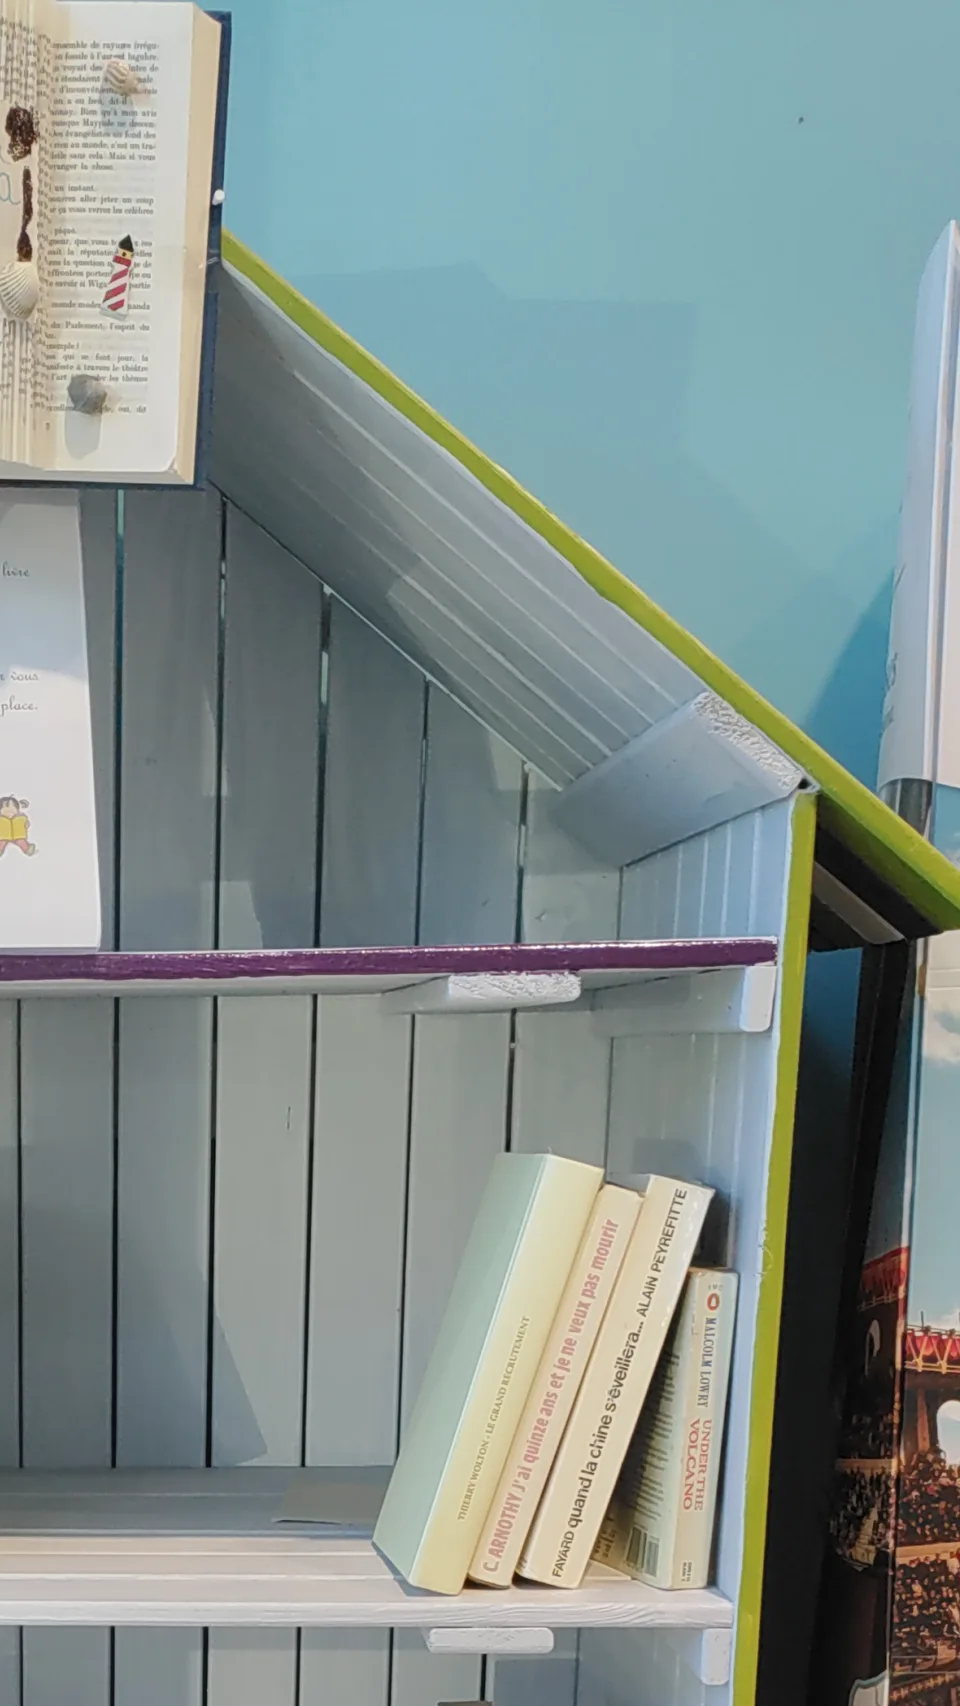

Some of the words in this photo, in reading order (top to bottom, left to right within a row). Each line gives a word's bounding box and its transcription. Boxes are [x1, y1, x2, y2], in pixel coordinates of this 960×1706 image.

[2, 561, 30, 578] livre
[10, 671, 39, 682] vous
[0, 696, 38, 717] place.
[587, 1218, 620, 1271] mourir
[649, 1186, 688, 1272] PEYREFITTE
[578, 1271, 603, 1300] pas
[635, 1273, 660, 1316] ALAIN
[567, 1299, 591, 1335] veux
[500, 1314, 531, 1385] RECRUTEMENT
[559, 1334, 578, 1357] ne
[700, 1316, 717, 1367] MALCOLM
[546, 1367, 567, 1390] et
[553, 1354, 574, 1372] je
[489, 1385, 508, 1421] GRAND
[538, 1389, 559, 1417] ans
[696, 1370, 711, 1407] LOWRY
[485, 1422, 496, 1434] LE
[519, 1415, 552, 1465] quinze
[587, 1412, 614, 1459] chine
[680, 1417, 701, 1510] VOLCANO
[697, 1419, 712, 1474] UNDER
[456, 1481, 477, 1521] THIERRY
[470, 1439, 491, 1480] WOLTON
[511, 1464, 533, 1493] J'ai
[581, 1458, 598, 1476] la
[564, 1475, 595, 1529] quand
[693, 1476, 706, 1511] THE
[486, 1491, 523, 1559] ARNOTHY
[549, 1528, 578, 1579] FAYARD
